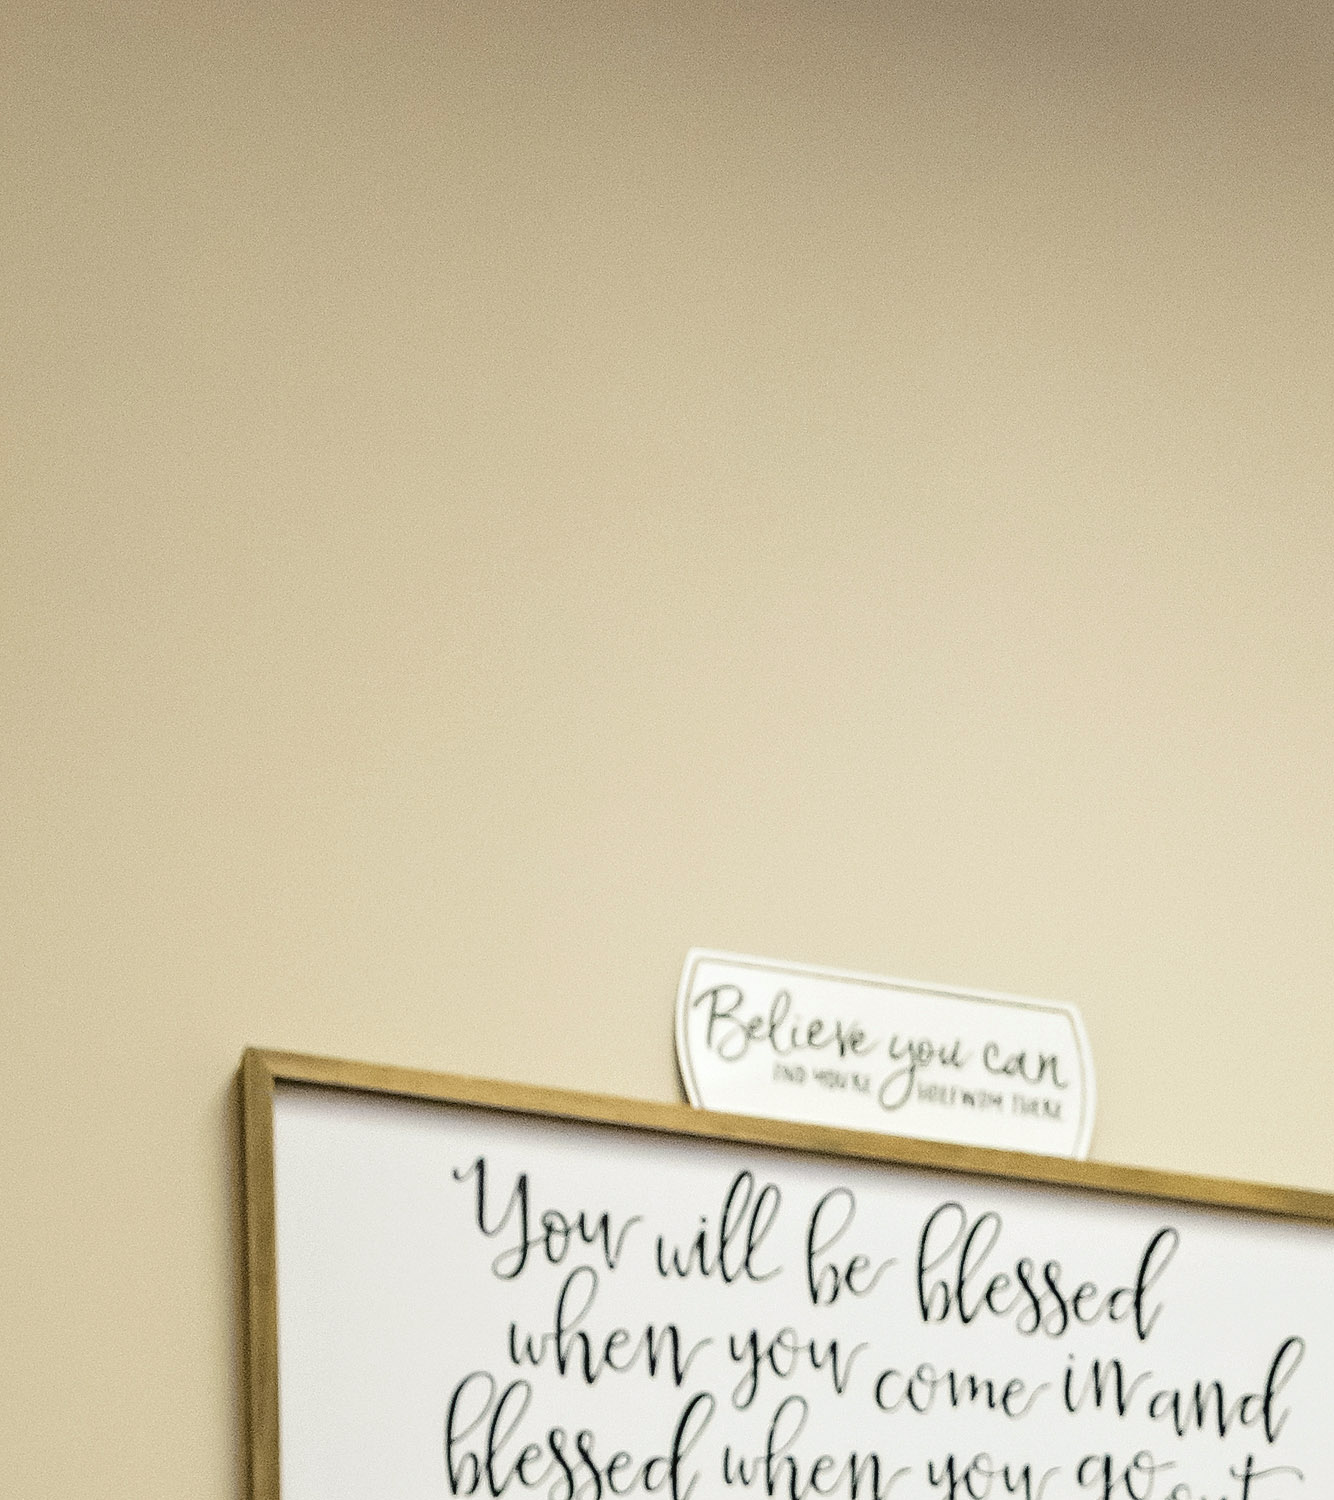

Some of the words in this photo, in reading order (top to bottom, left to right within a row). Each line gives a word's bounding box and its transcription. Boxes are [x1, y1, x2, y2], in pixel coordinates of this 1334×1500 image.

[694, 984, 874, 1063] Believe
[880, 1034, 969, 1112] you
[982, 1040, 1069, 1088] can
[452, 1156, 642, 1280] You
[653, 1169, 783, 1283] will
[806, 1188, 897, 1306] be
[917, 1202, 1180, 1340] blessed
[508, 1266, 714, 1387] when
[729, 1326, 869, 1409] you
[875, 1363, 1049, 1418] come
[1149, 1336, 1305, 1443] and
